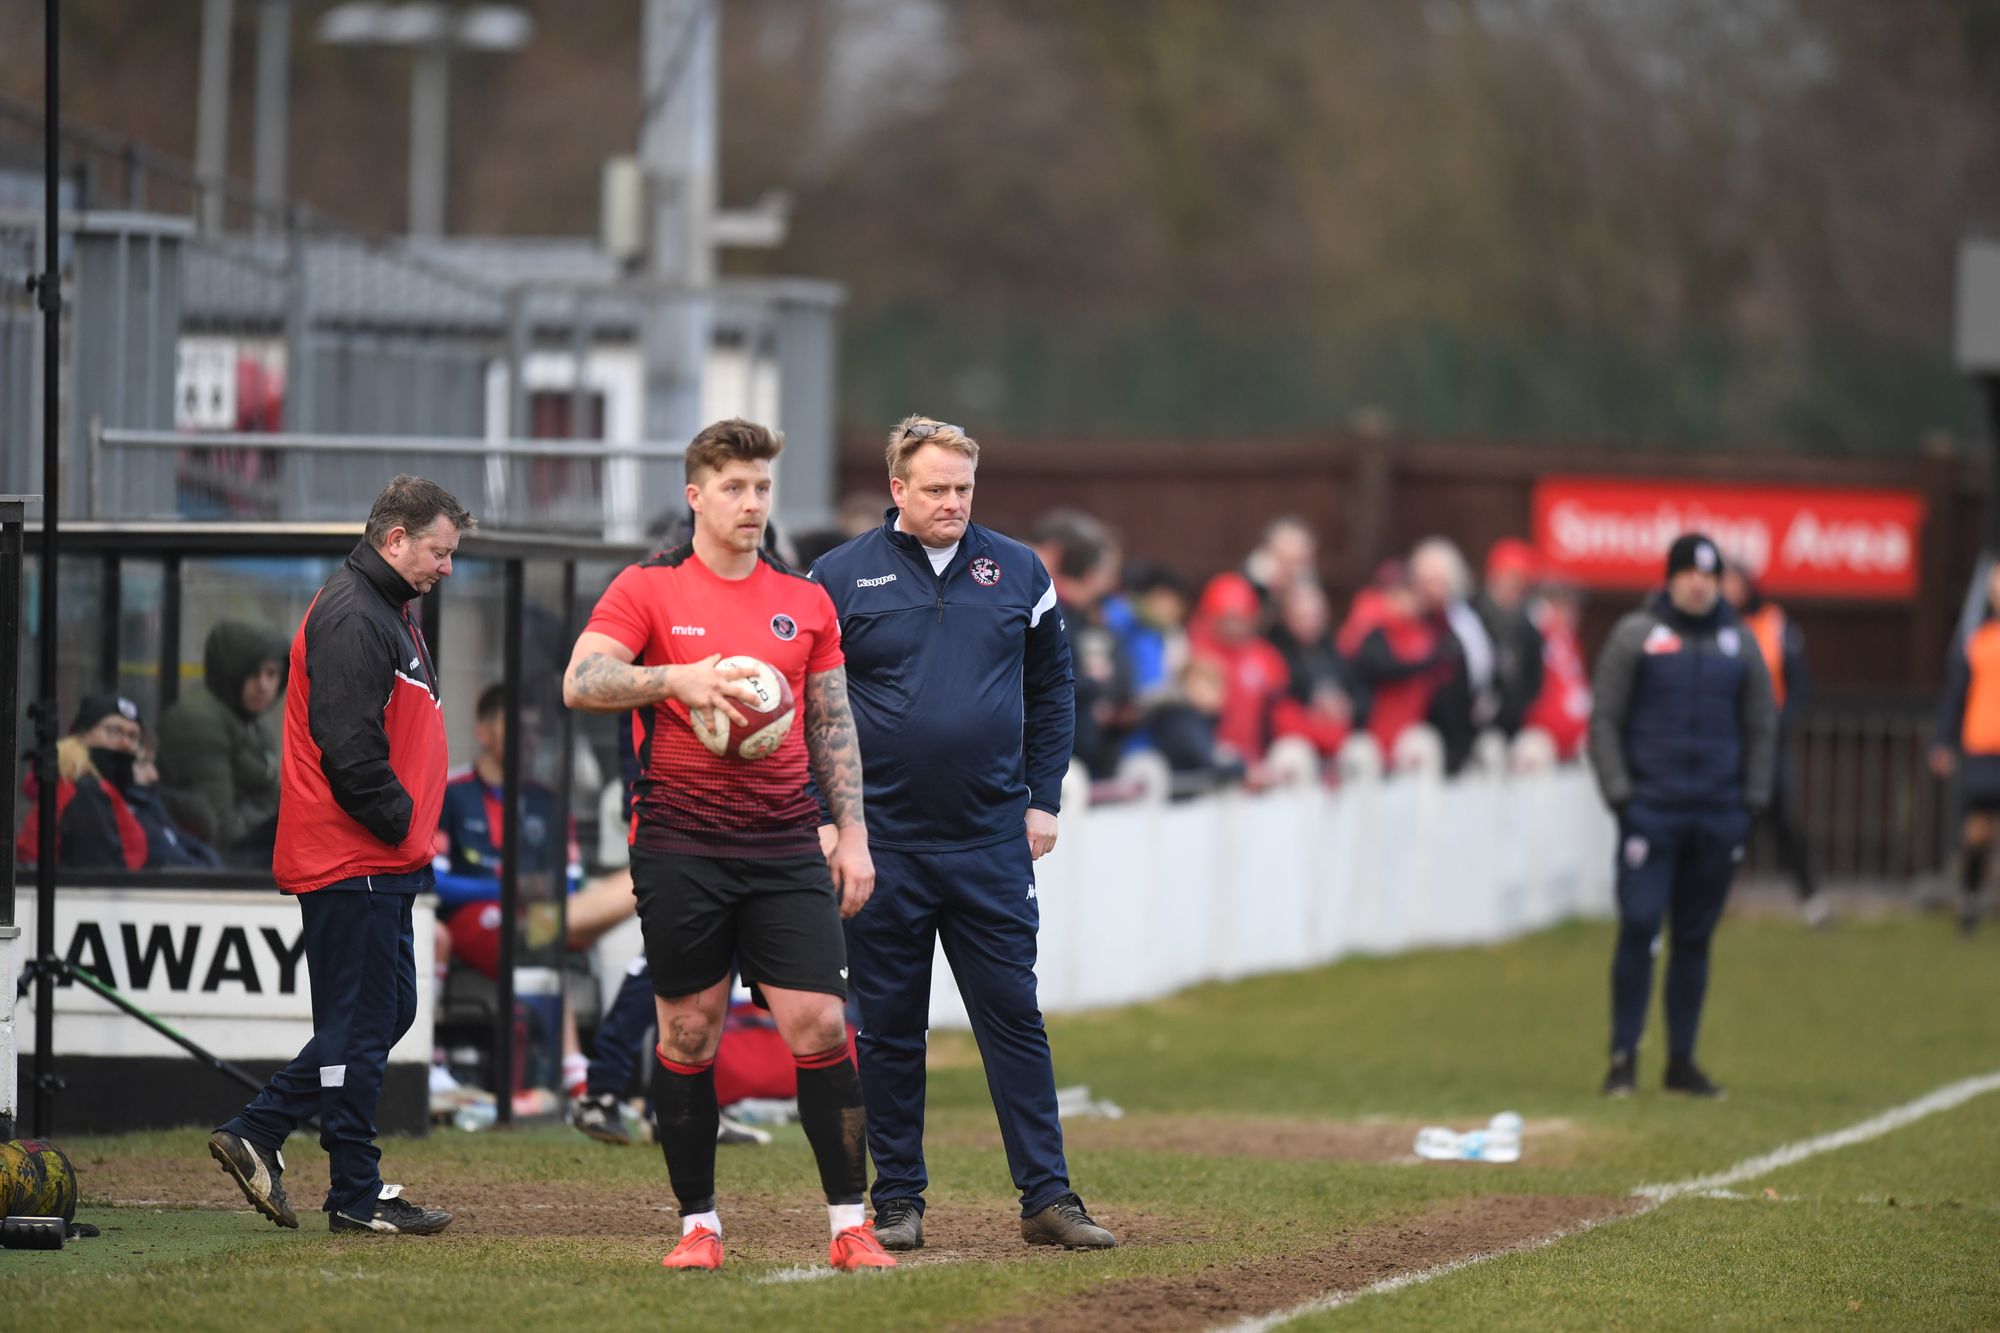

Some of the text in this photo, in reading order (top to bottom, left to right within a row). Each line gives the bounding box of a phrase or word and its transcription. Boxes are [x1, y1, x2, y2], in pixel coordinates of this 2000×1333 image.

[1784, 511, 1911, 572] Area
[857, 574, 897, 587] Kappa
[671, 625, 706, 636] mitre
[56, 921, 305, 995] AWAY
